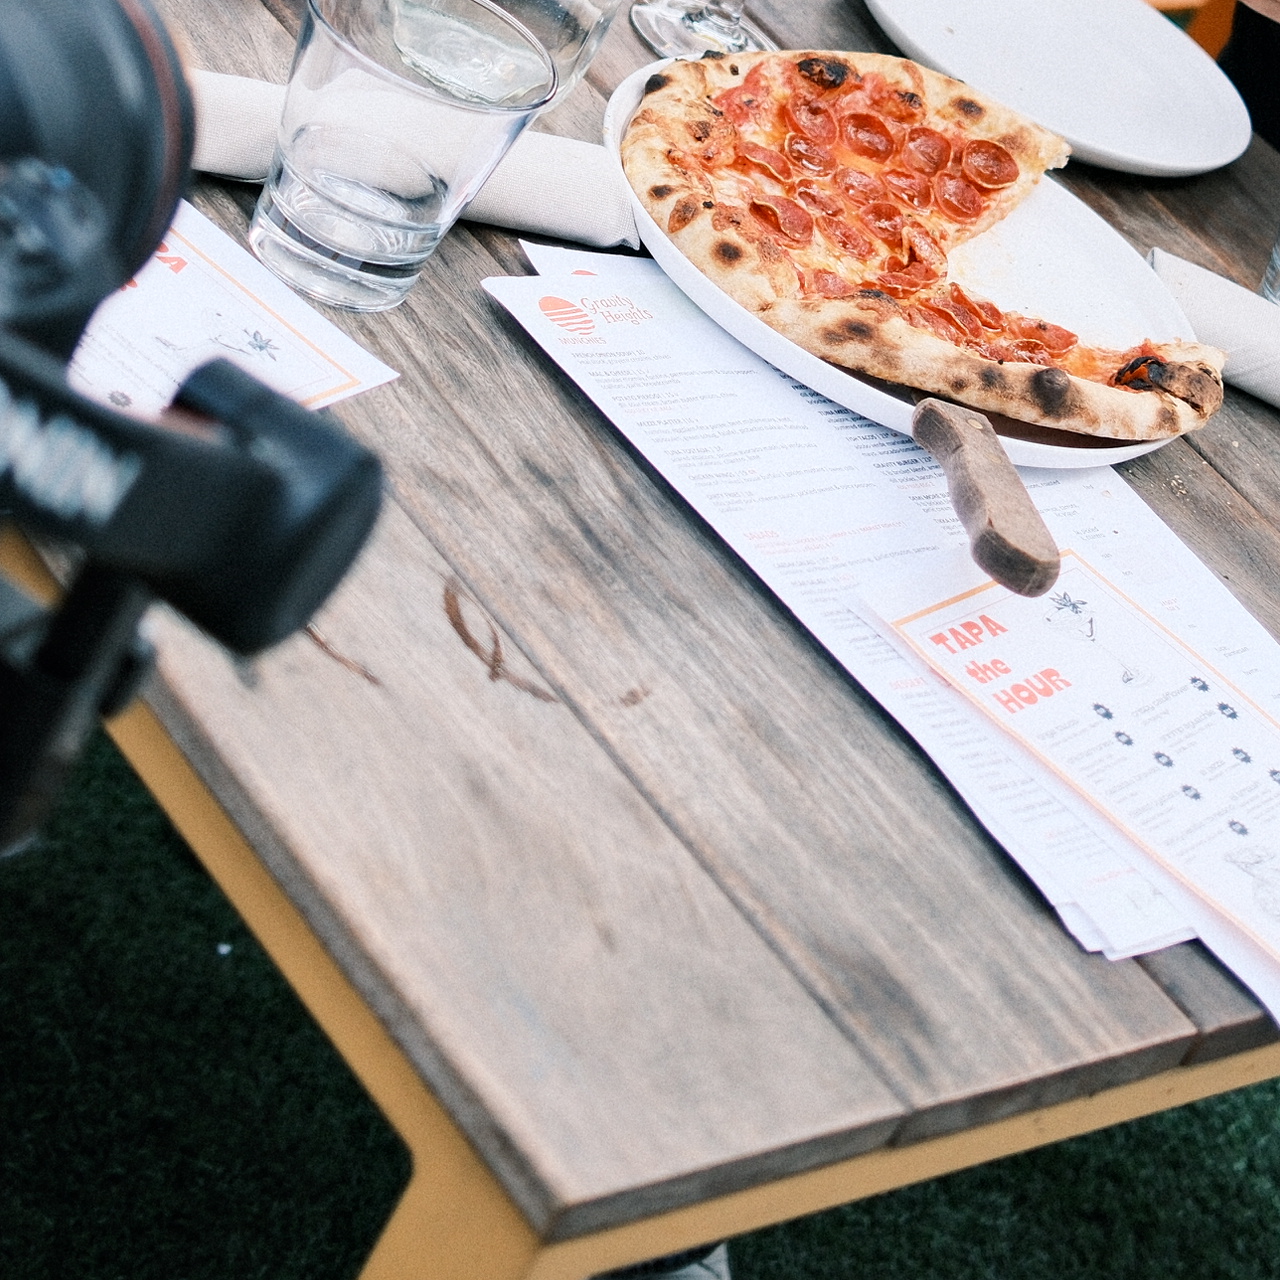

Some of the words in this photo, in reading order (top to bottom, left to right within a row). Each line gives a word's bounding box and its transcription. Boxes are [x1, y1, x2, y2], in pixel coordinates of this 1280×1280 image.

[580, 294, 634, 314] Gravity
[599, 307, 654, 325] Heights
[558, 336, 606, 345] MUNCHIES
[929, 613, 1008, 655] TAPA
[967, 657, 1011, 685] the
[993, 668, 1072, 714] HOUR
